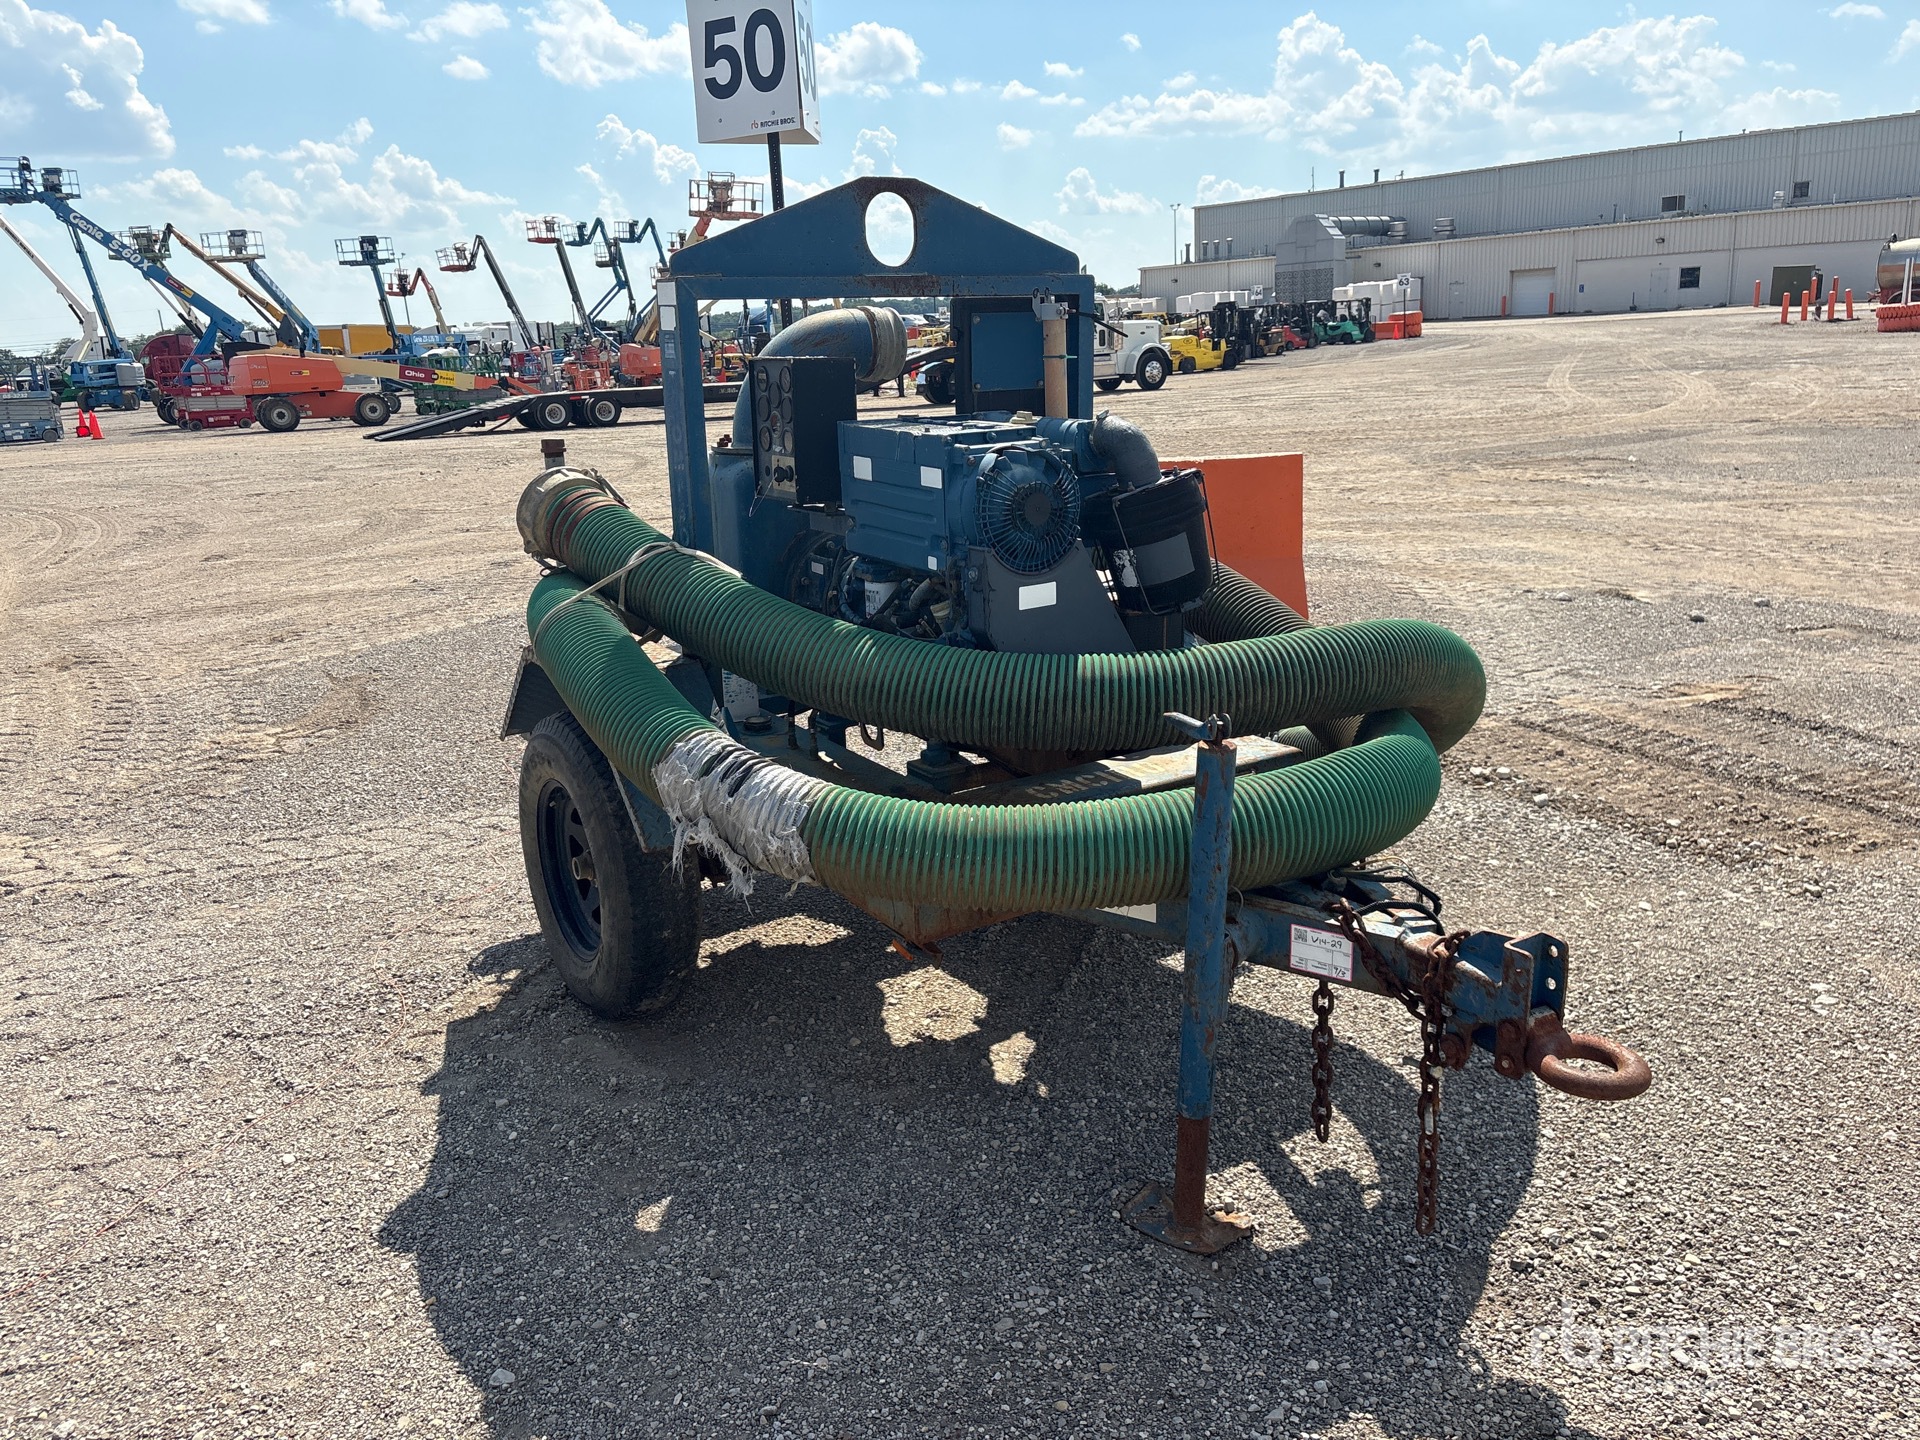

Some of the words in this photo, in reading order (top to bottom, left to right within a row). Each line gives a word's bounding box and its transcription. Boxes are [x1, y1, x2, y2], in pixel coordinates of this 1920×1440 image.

[704, 8, 786, 100] 50
[797, 10, 817, 102] 50
[760, 119, 780, 128] RITCHIE
[69, 212, 104, 241] Genie
[1398, 277, 1409, 286] 63
[1255, 288, 1262, 296] 64
[404, 370, 425, 378] Ohio
[1311, 935, 1342, 950] V14-29
